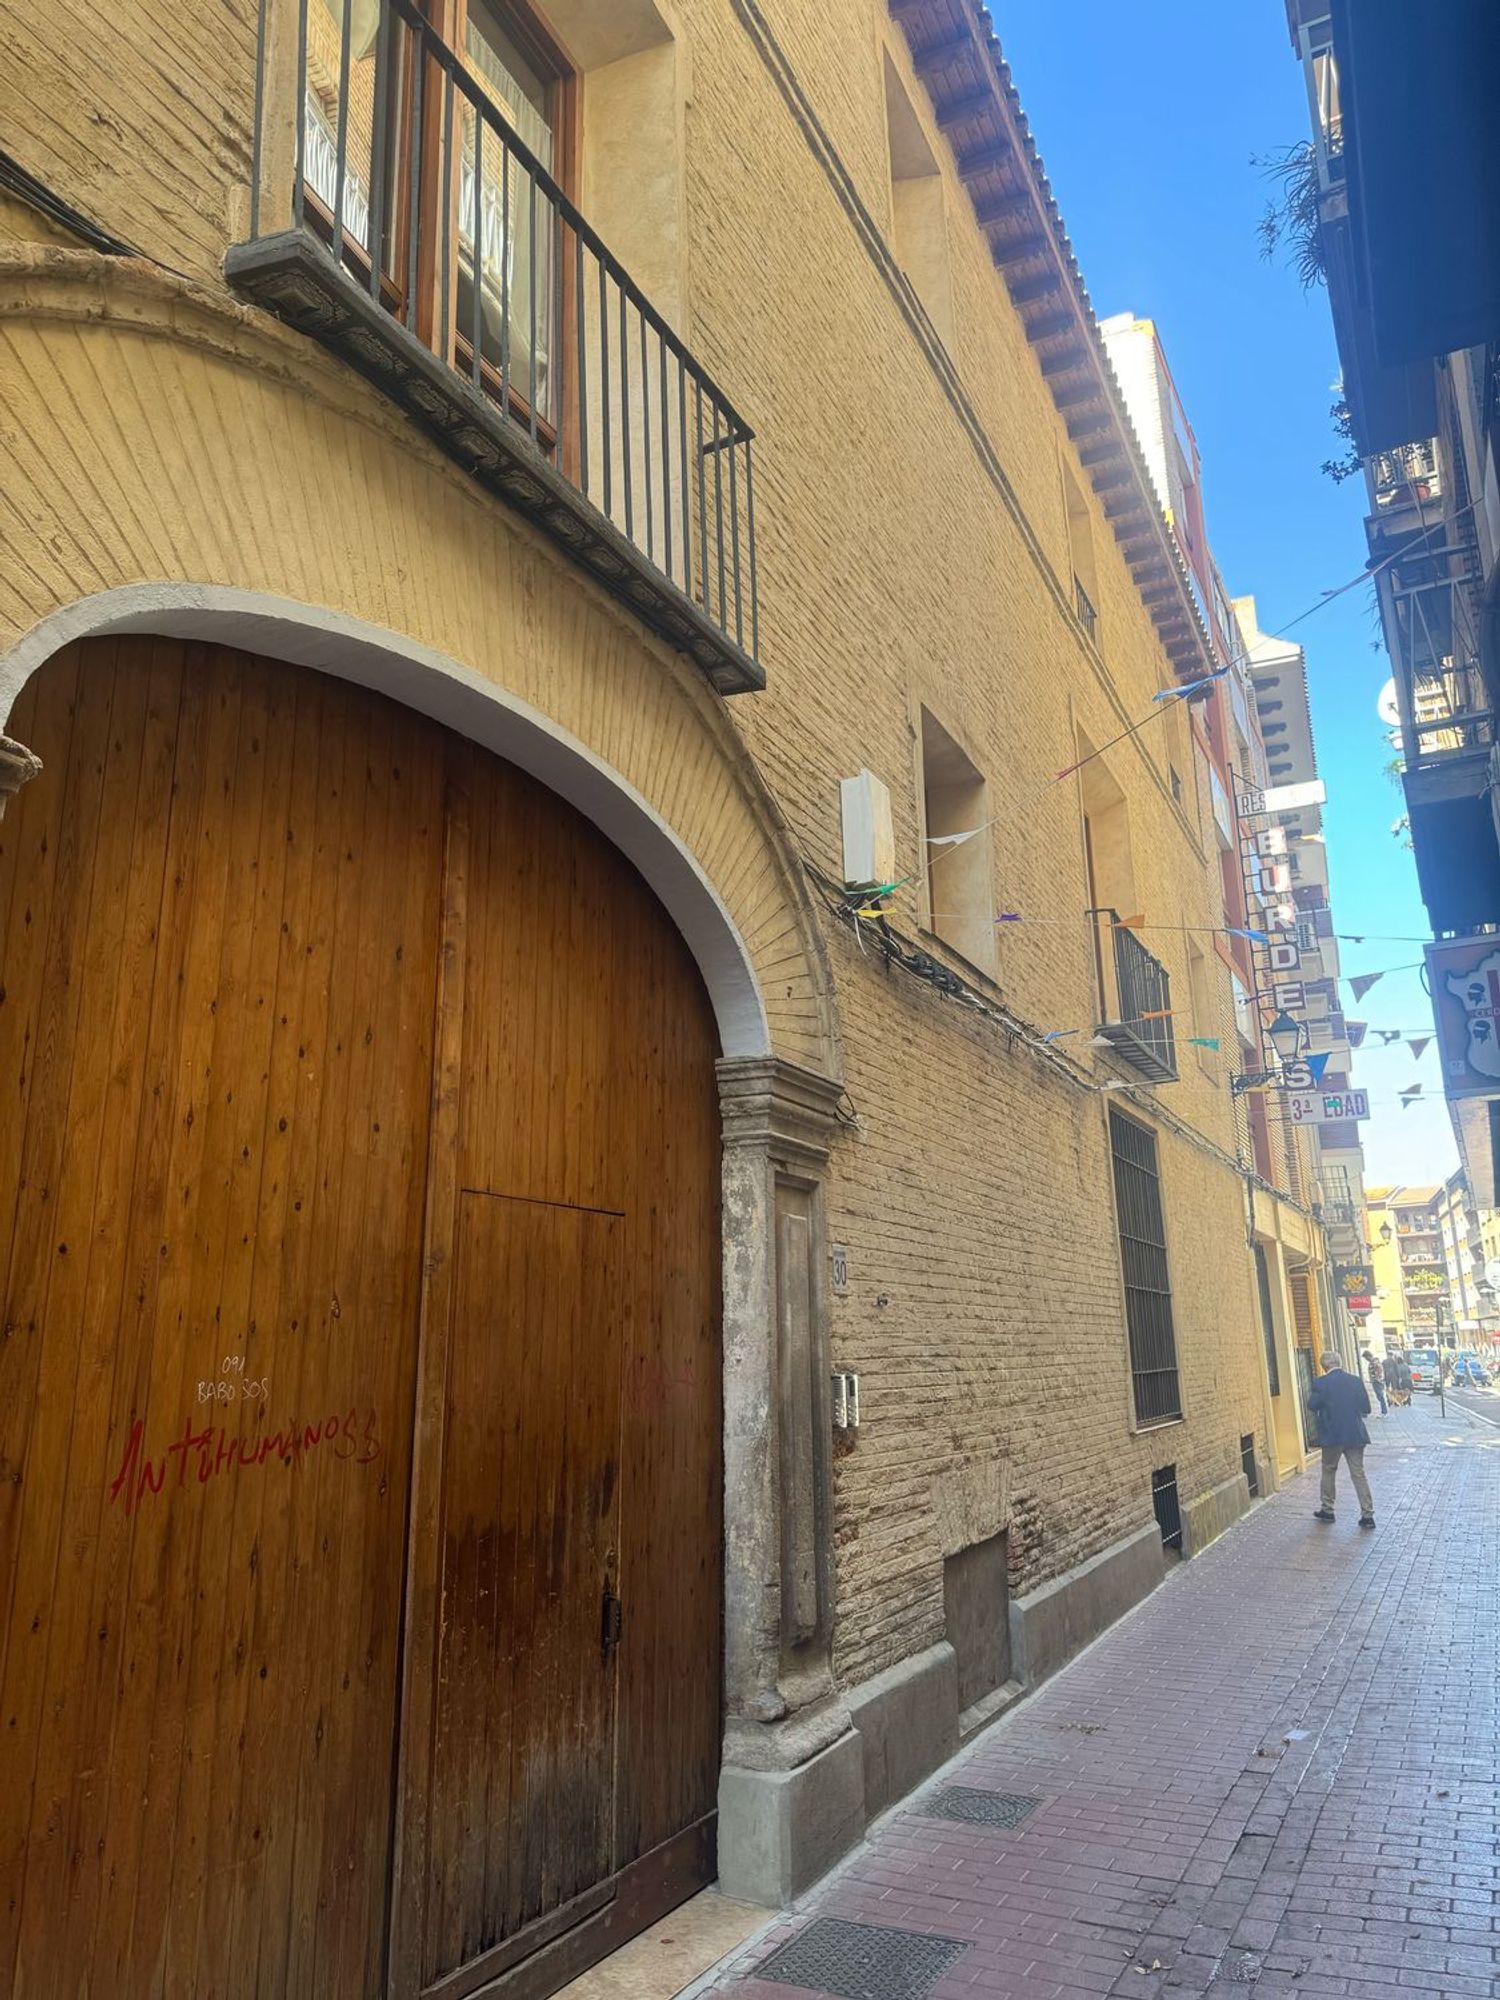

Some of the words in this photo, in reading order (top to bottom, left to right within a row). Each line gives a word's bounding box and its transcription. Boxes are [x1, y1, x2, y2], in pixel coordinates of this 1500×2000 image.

[1322, 1094, 1366, 1118] EDAD
[834, 1259, 847, 1286] 30
[241, 1377, 268, 1400] SOS
